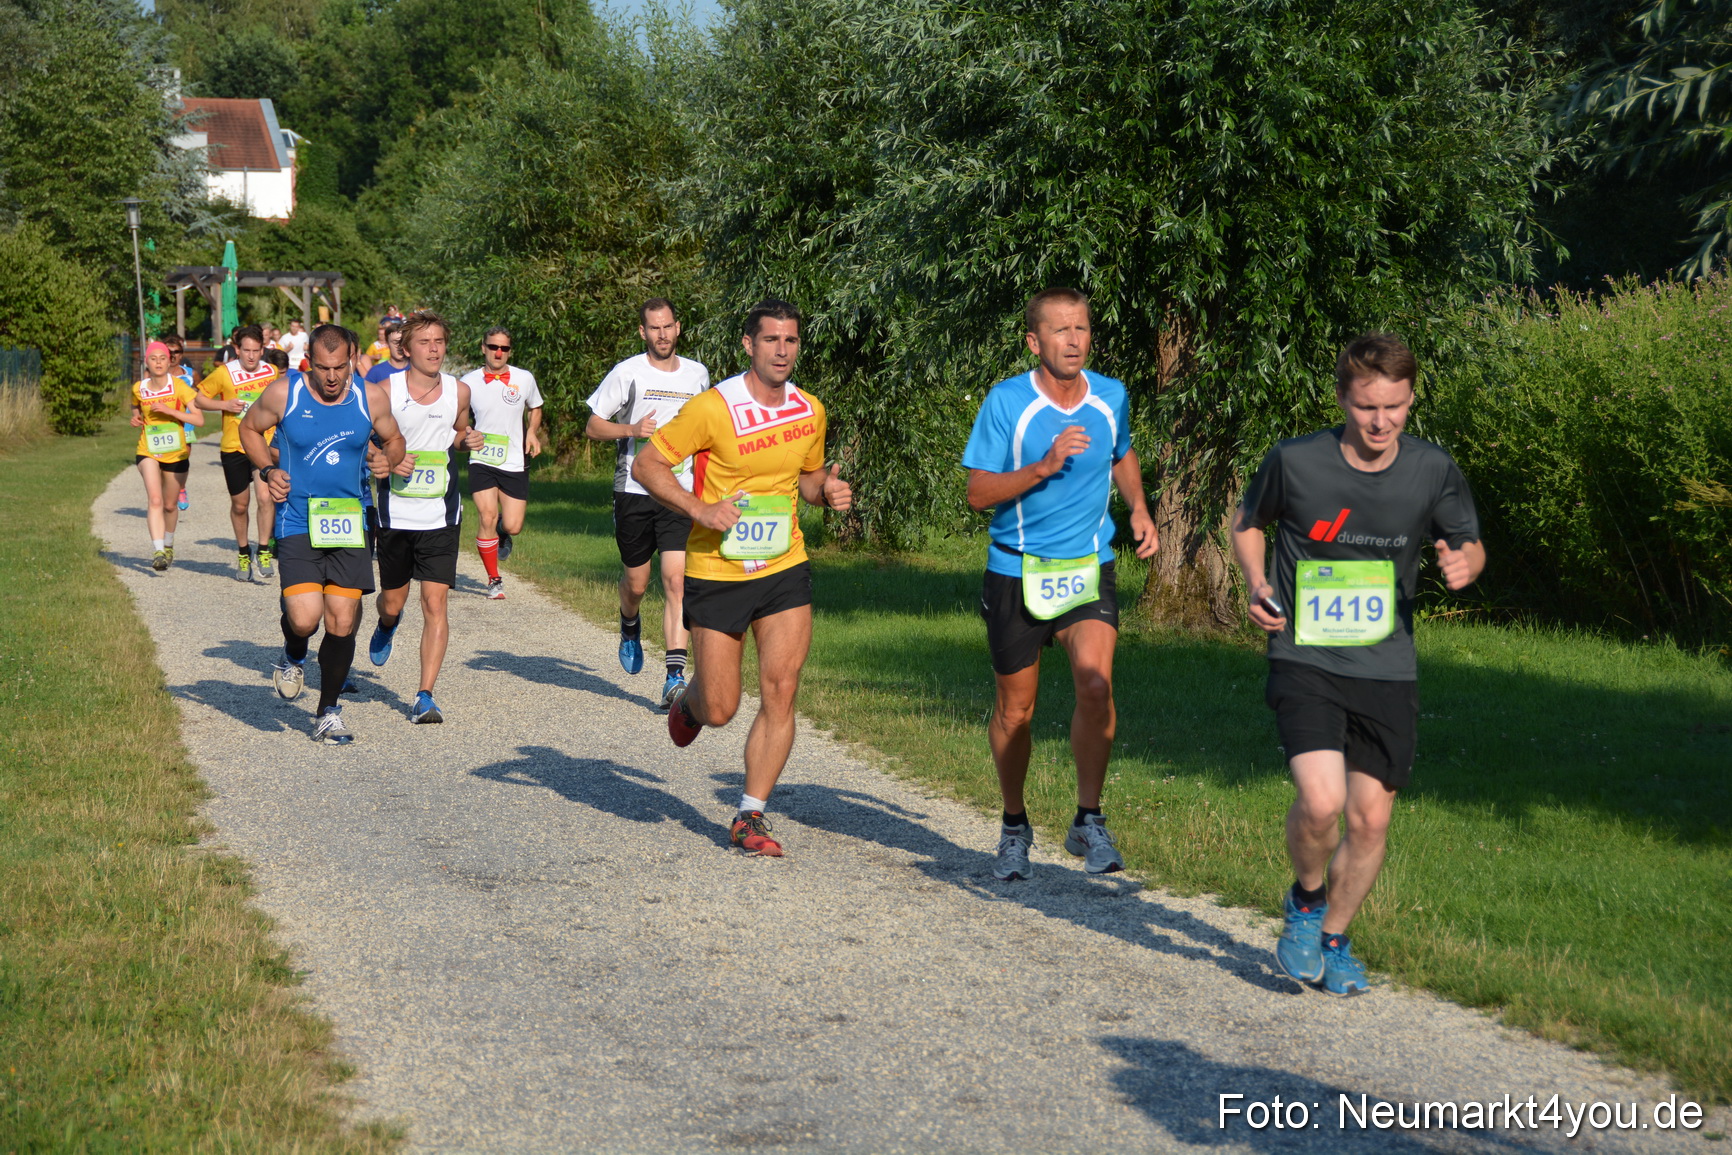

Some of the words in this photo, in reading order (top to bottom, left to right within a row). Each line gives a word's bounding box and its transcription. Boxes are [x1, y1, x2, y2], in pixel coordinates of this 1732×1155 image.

[153, 434, 174, 446] 919
[303, 447, 318, 462] Team
[317, 433, 339, 448] Schick
[339, 429, 355, 438] Bau
[737, 434, 779, 456] MAX
[783, 423, 816, 443] BÖGL
[319, 518, 352, 535] 850
[735, 521, 779, 542] 907
[1336, 531, 1408, 548] duerrer.de
[1040, 575, 1085, 600] 556
[1307, 595, 1384, 622] 1419
